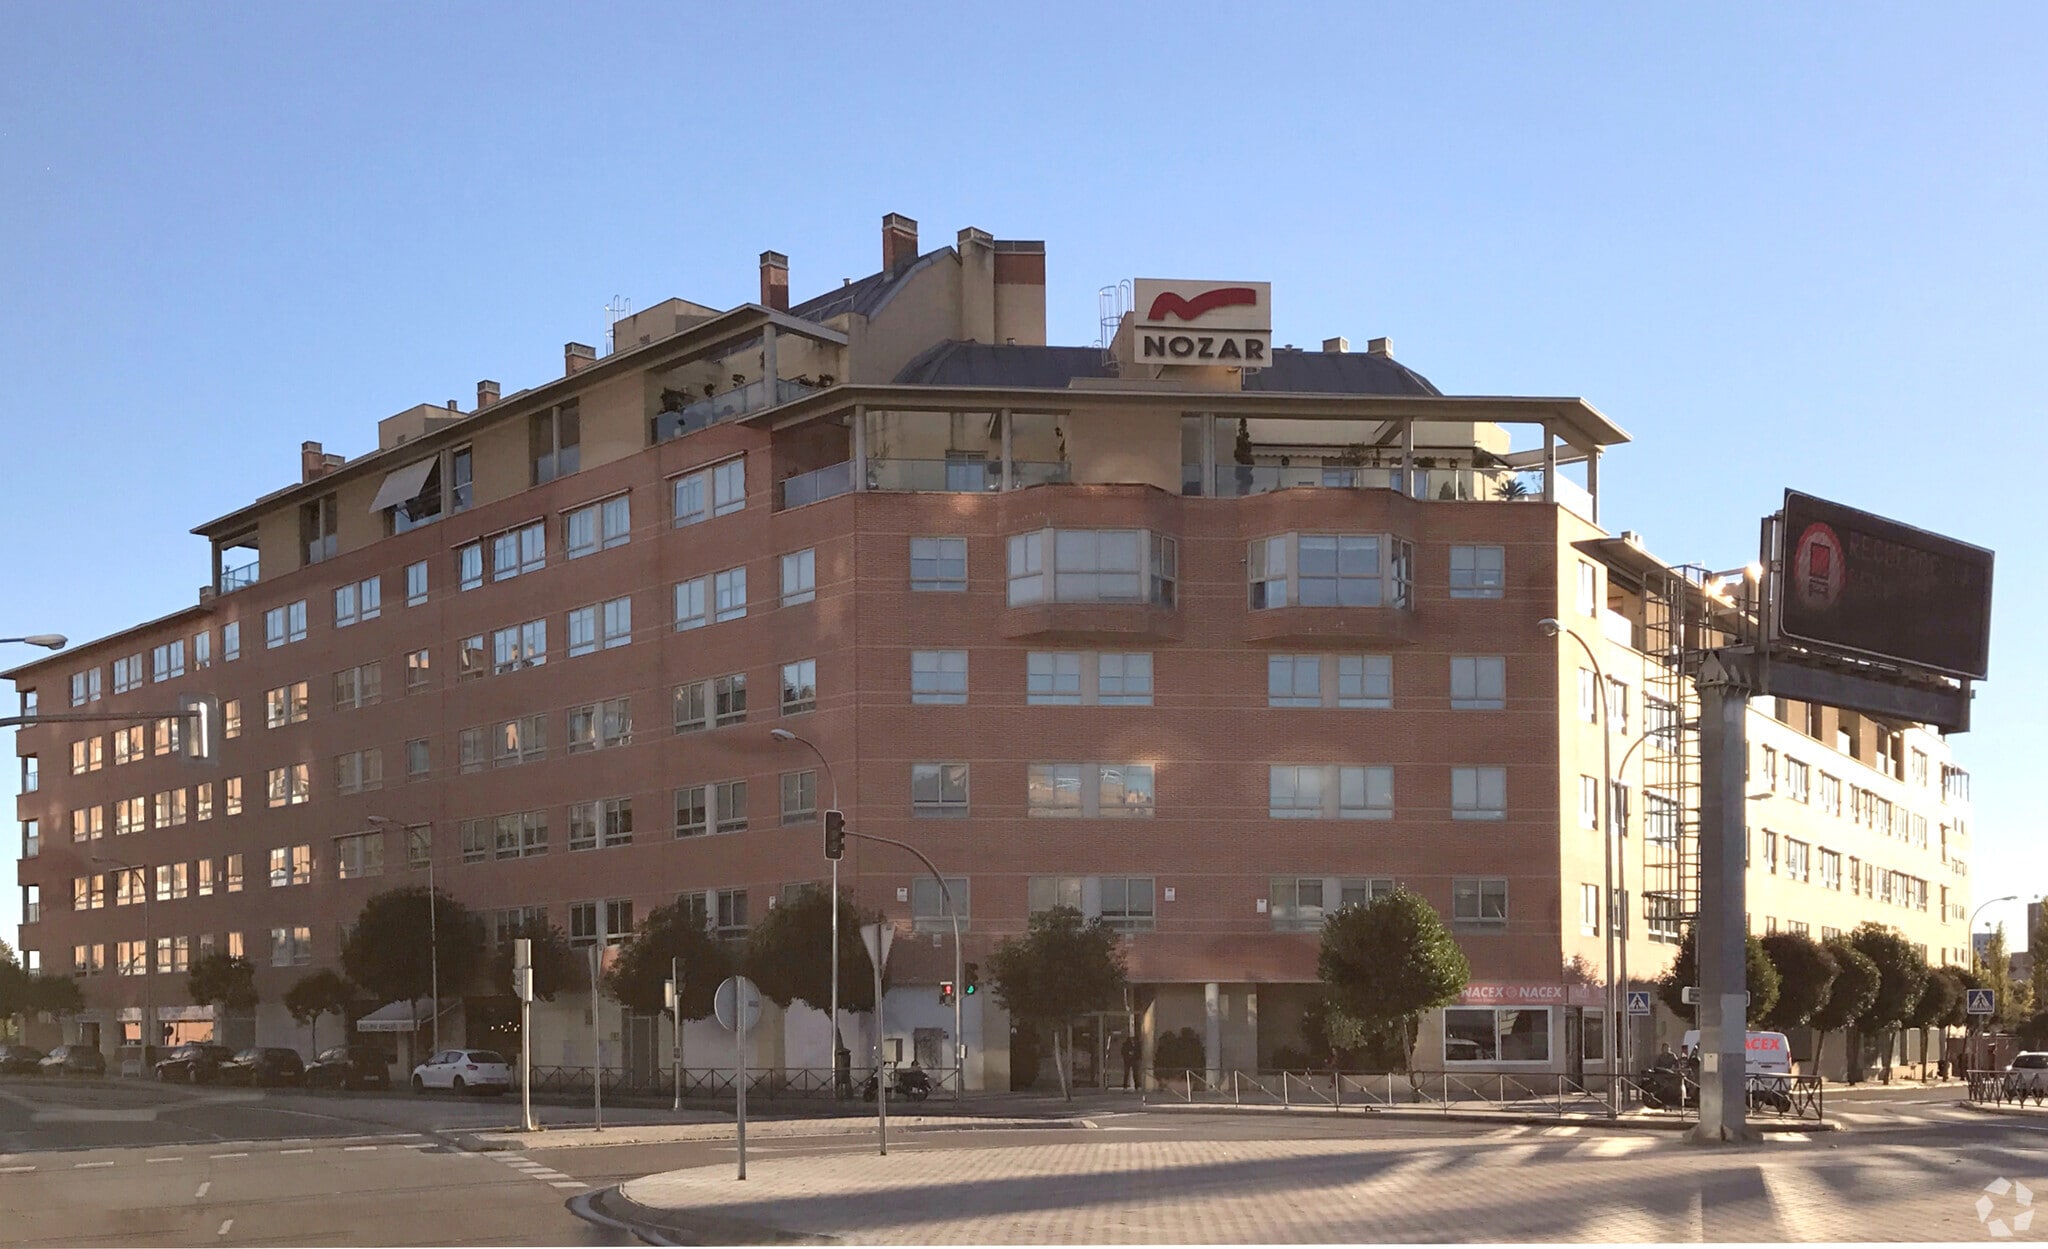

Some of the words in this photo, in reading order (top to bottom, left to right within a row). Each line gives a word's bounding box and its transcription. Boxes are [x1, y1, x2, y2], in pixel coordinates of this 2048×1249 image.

[1144, 336, 1264, 360] NOZAR
[1461, 986, 1504, 998] NACEX
[1520, 986, 1562, 998] NACEX
[1745, 1038, 1780, 1050] ACEX
